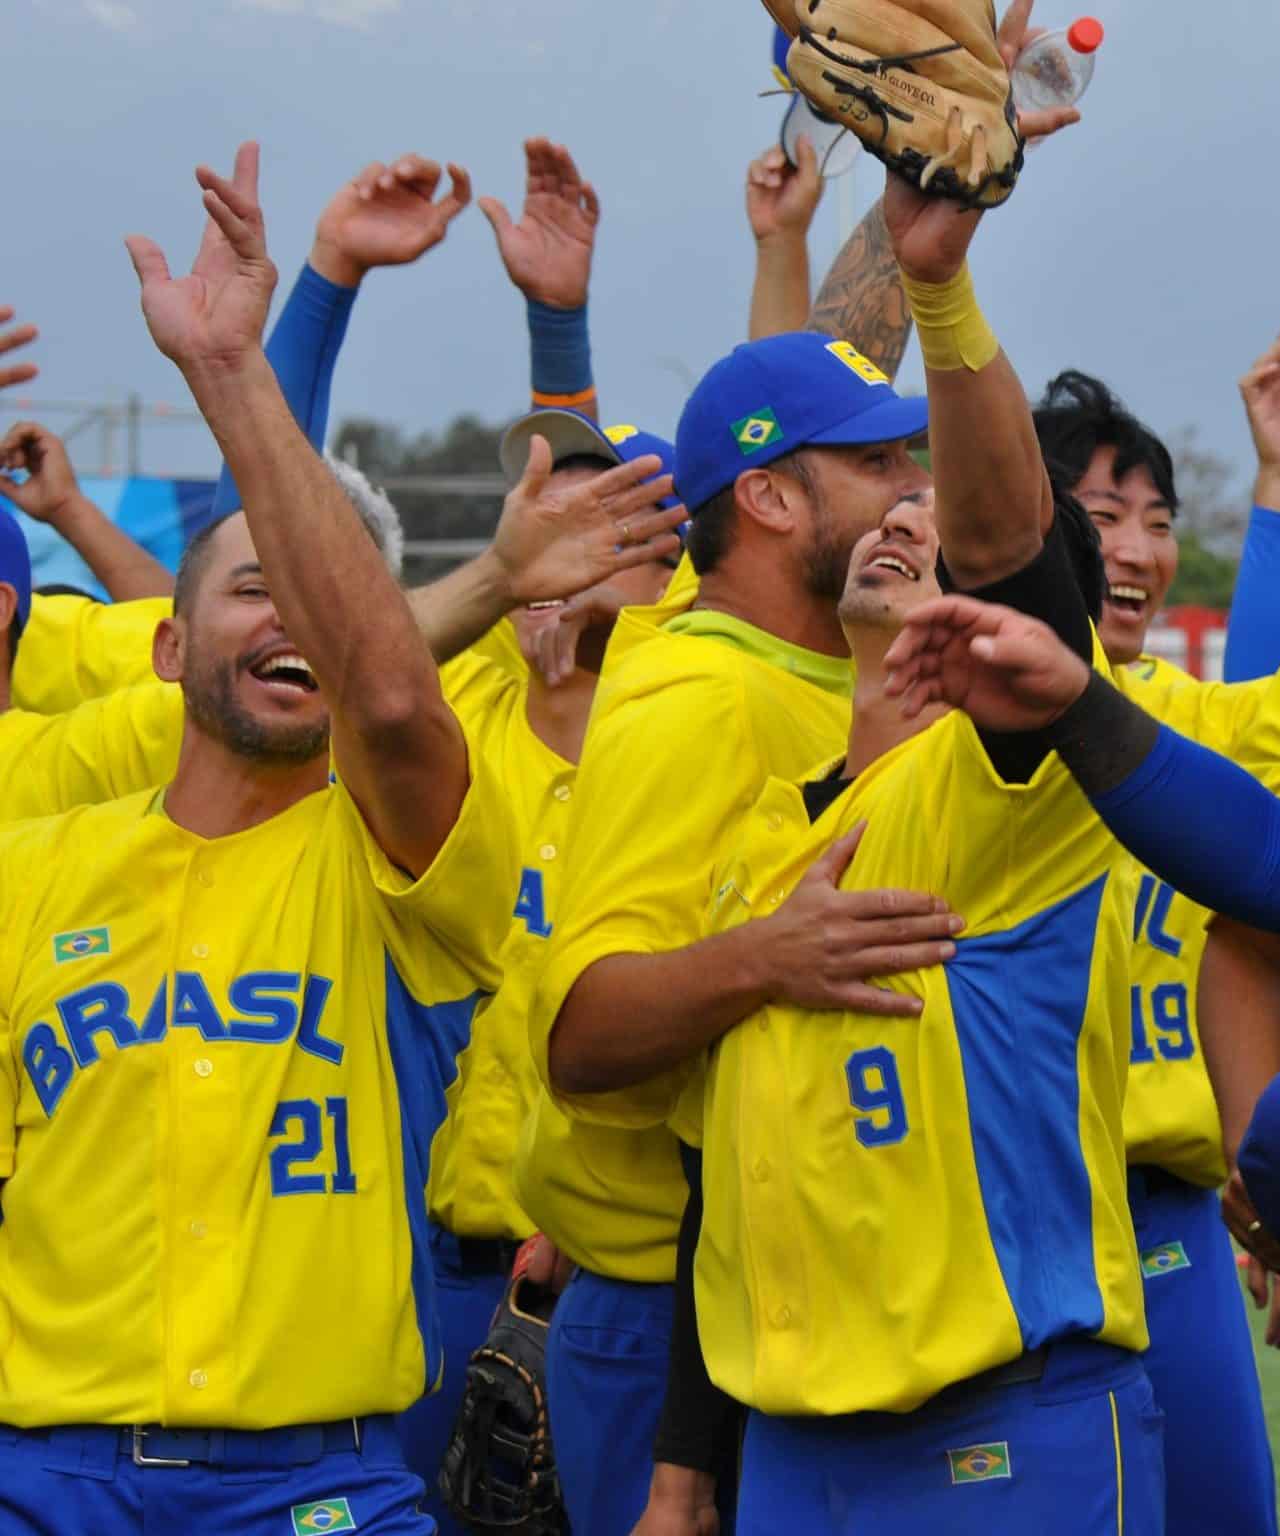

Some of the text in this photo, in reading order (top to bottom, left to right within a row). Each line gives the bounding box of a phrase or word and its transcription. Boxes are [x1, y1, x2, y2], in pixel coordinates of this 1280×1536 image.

[1129, 982, 1196, 1065] 19
[267, 1096, 357, 1198] 21
[844, 1045, 910, 1149] 9
